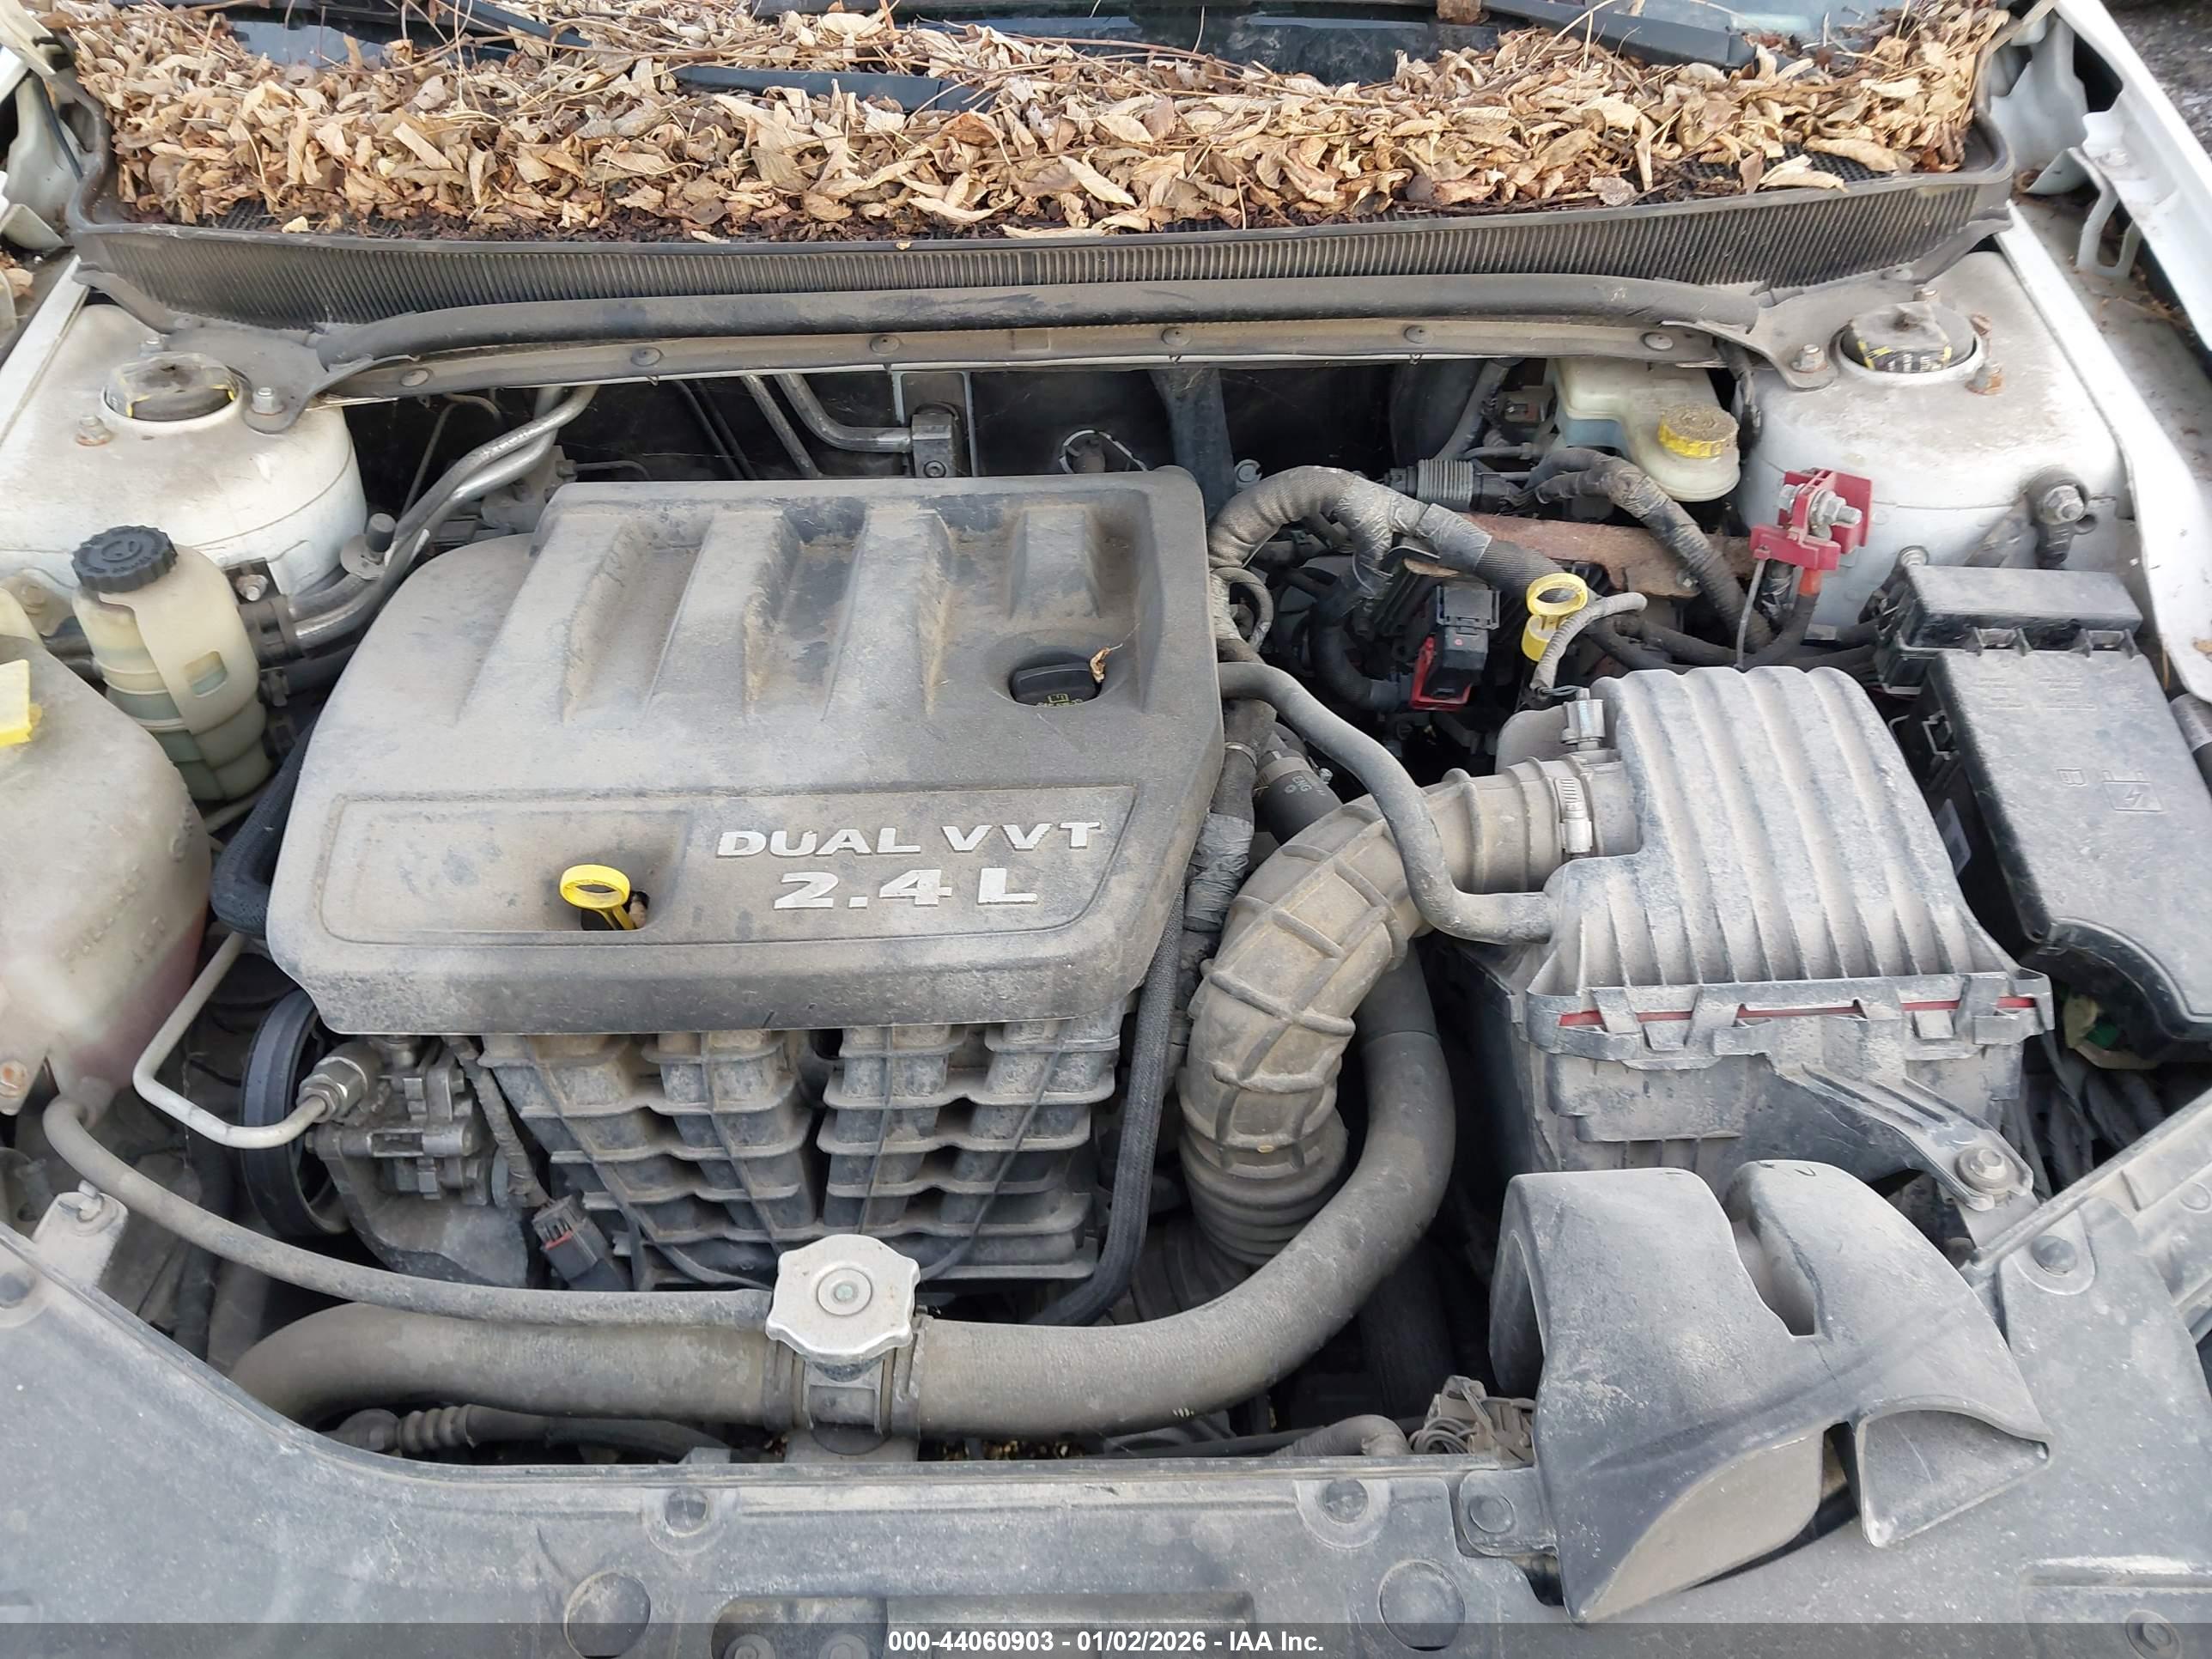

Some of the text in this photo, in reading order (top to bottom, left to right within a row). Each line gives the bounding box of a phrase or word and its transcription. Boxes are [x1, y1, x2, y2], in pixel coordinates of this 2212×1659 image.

[716, 822, 1101, 857] DUAL VVT
[773, 867, 1037, 910] 2.4 L
